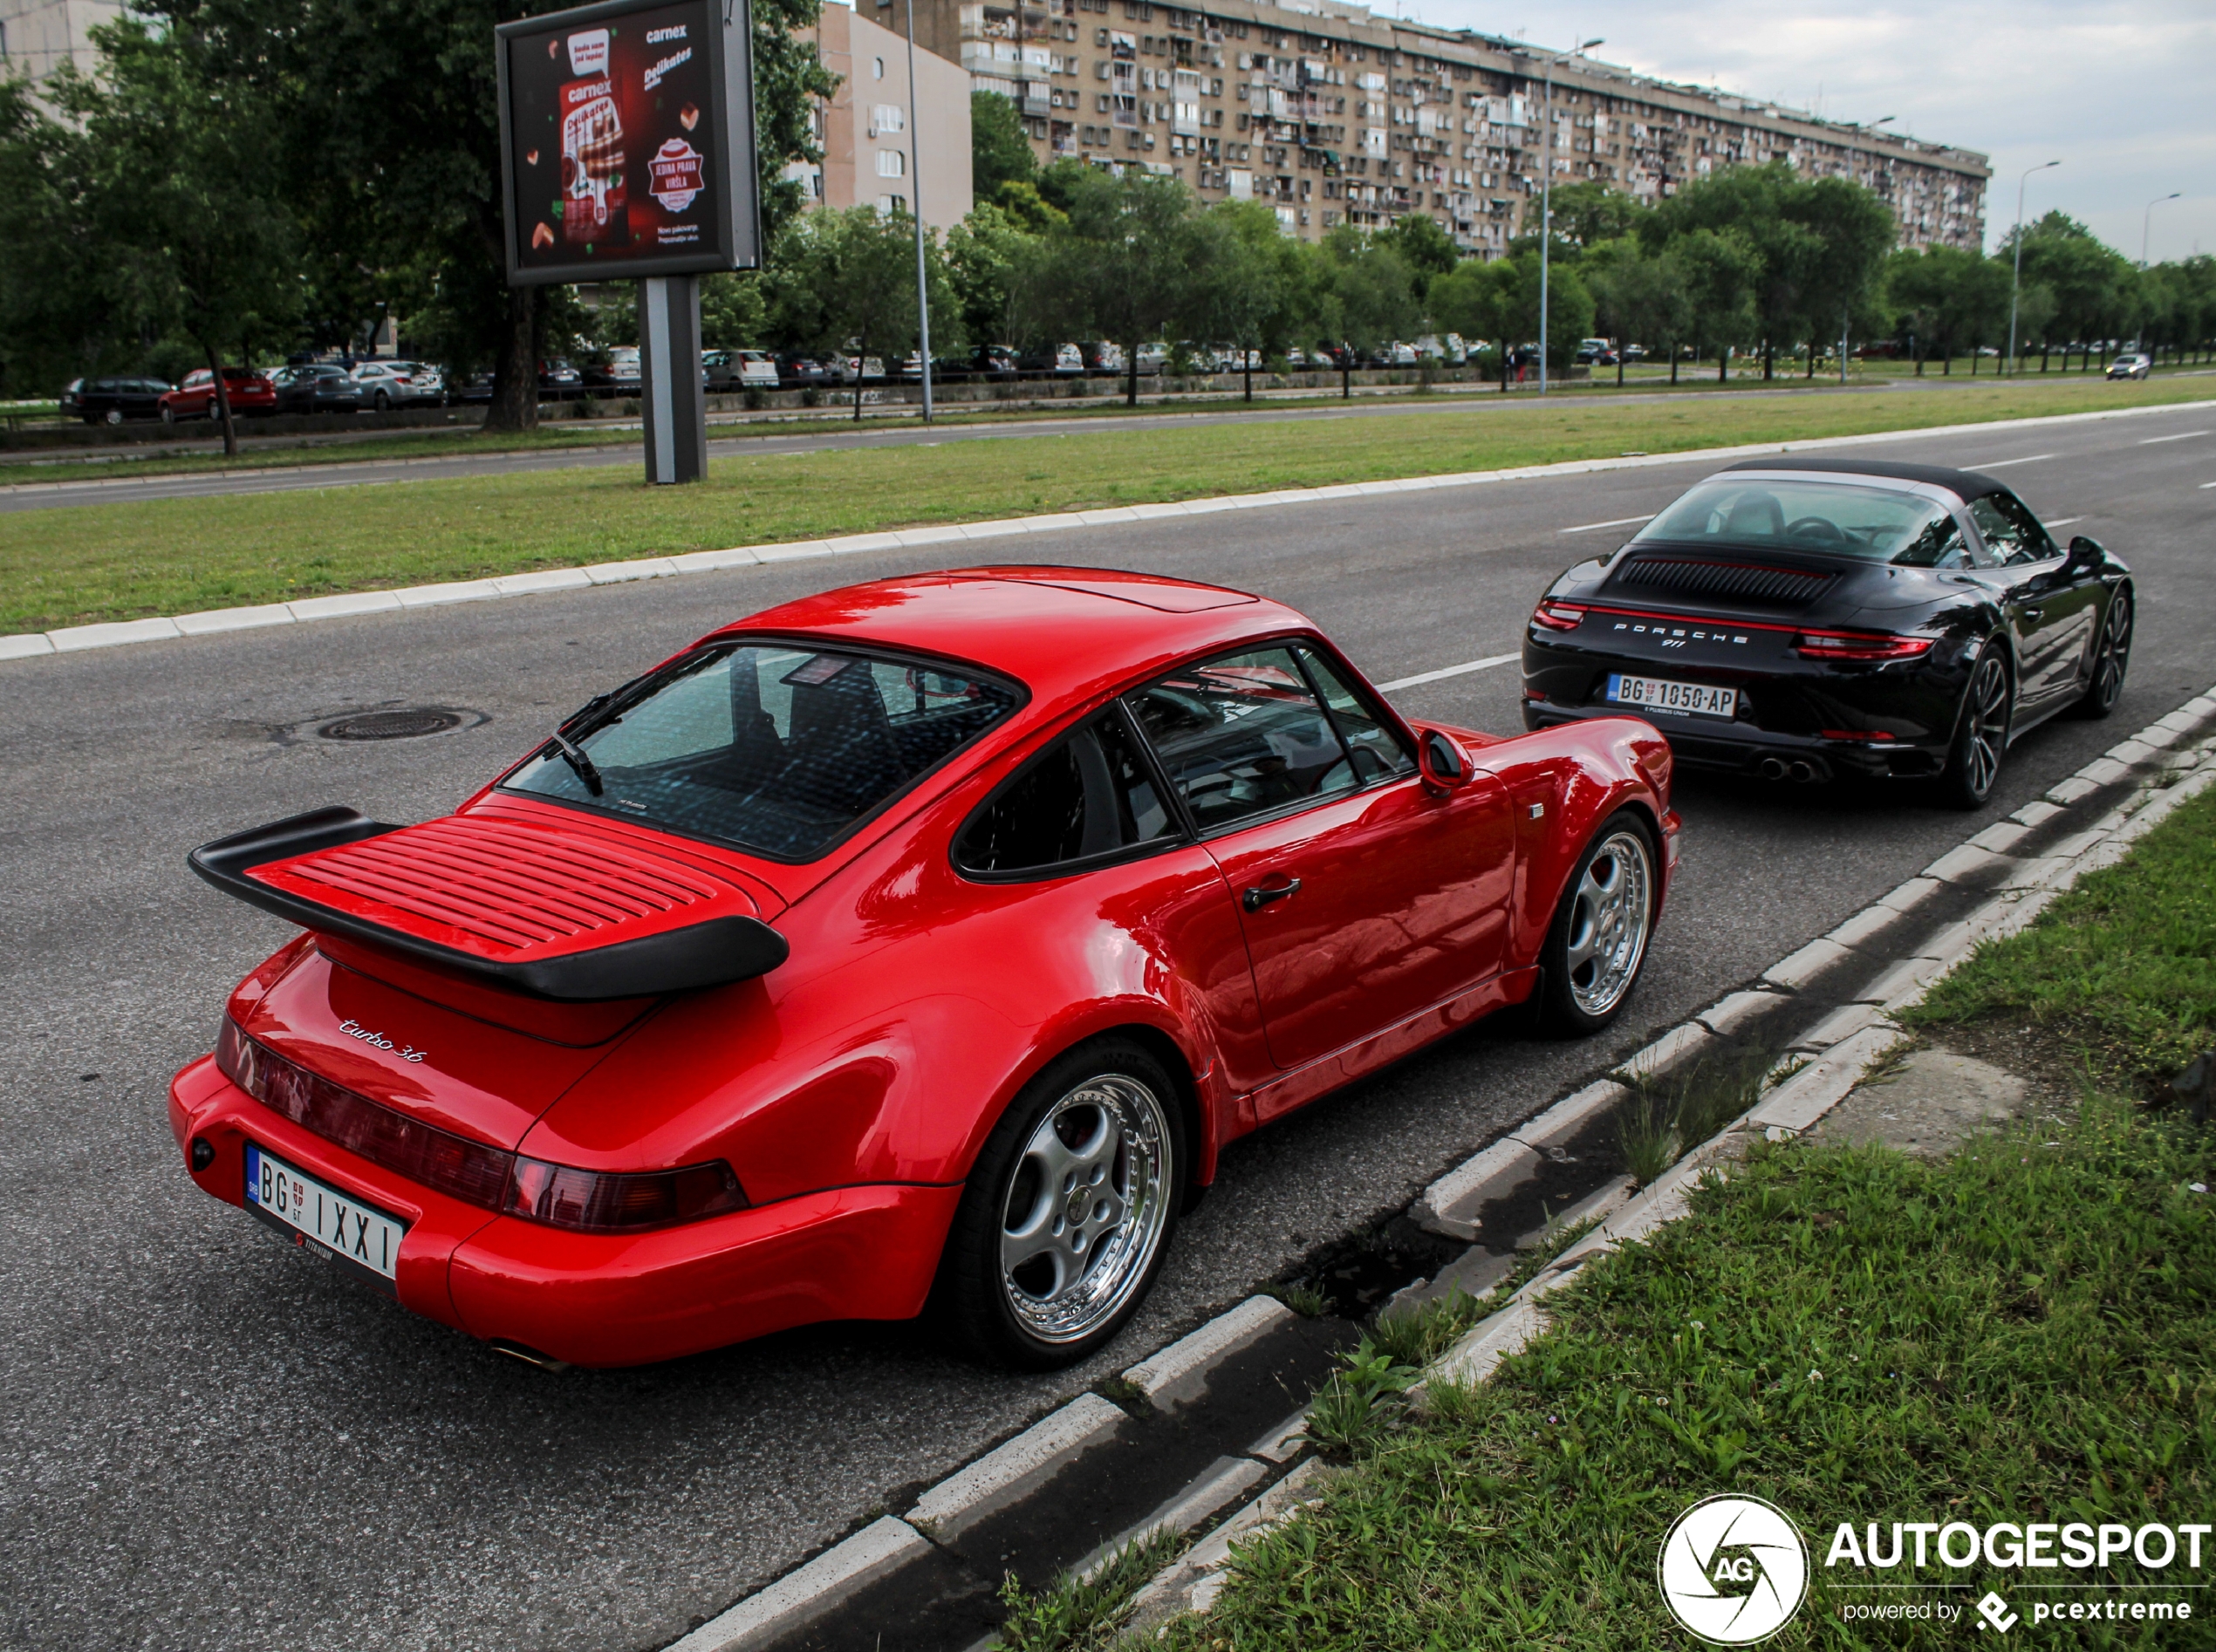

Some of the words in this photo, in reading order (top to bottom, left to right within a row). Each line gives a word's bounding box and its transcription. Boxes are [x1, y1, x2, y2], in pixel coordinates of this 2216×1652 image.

[646, 24, 687, 44] carnex
[644, 46, 692, 84] Delikates
[568, 79, 612, 103] carnex
[568, 99, 609, 130] Delikates
[655, 162, 676, 176] JEDINA
[676, 160, 697, 173] PRAVA
[665, 175, 687, 189] VIRŠLA
[1614, 623, 1748, 644] PORSCHE
[1661, 638, 1686, 648] 911
[1621, 678, 1644, 701] BG
[1649, 707, 1672, 715] PLURIBUS
[339, 1020, 393, 1050] turbo
[249, 1181, 258, 1196] SRB
[263, 1161, 287, 1213] BG
[305, 1238, 333, 1261] TITANIUM
